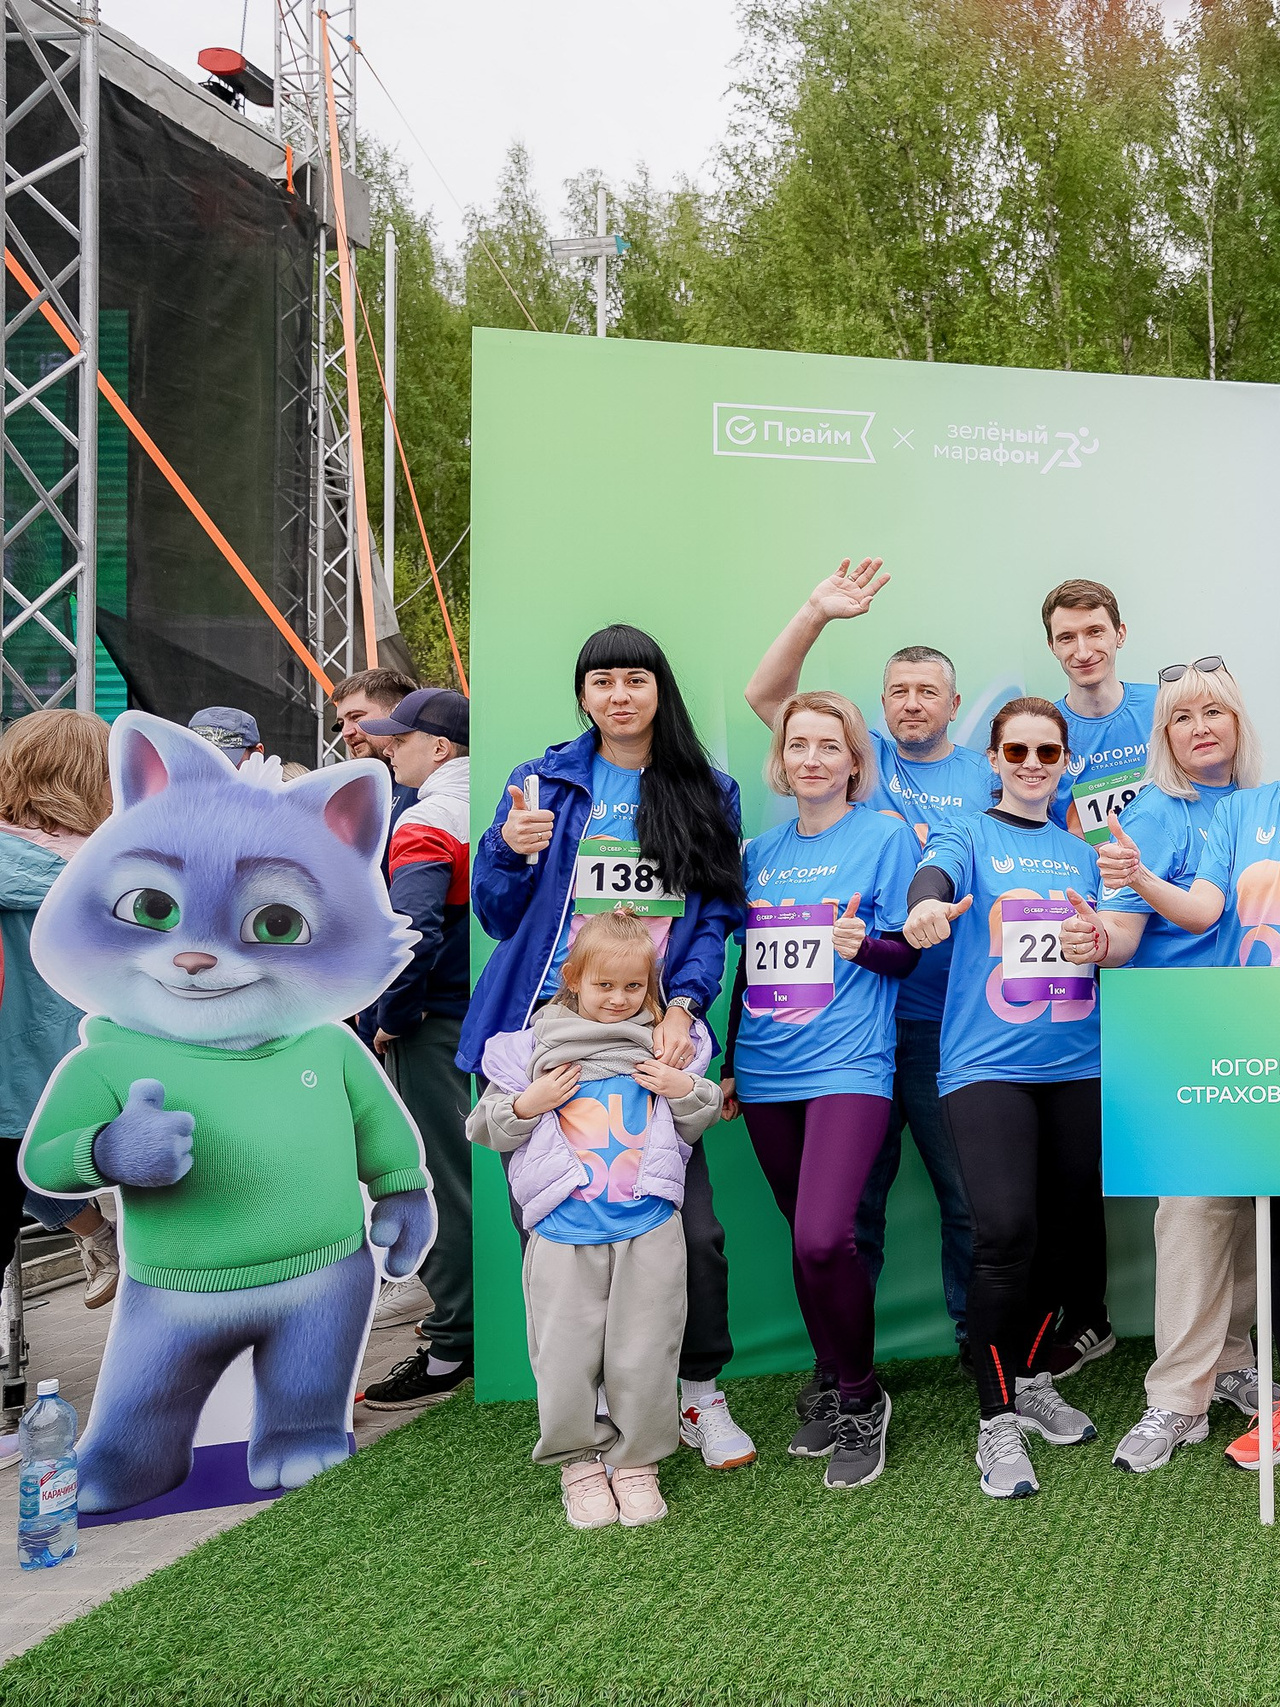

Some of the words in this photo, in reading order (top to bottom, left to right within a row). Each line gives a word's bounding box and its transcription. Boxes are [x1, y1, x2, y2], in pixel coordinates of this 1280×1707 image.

[763, 420, 851, 447] Прайм
[947, 422, 1048, 445] зелёный
[933, 444, 1039, 467] марафон
[1018, 857, 1080, 876] ЮГОРИЯ
[755, 939, 821, 970] 2187
